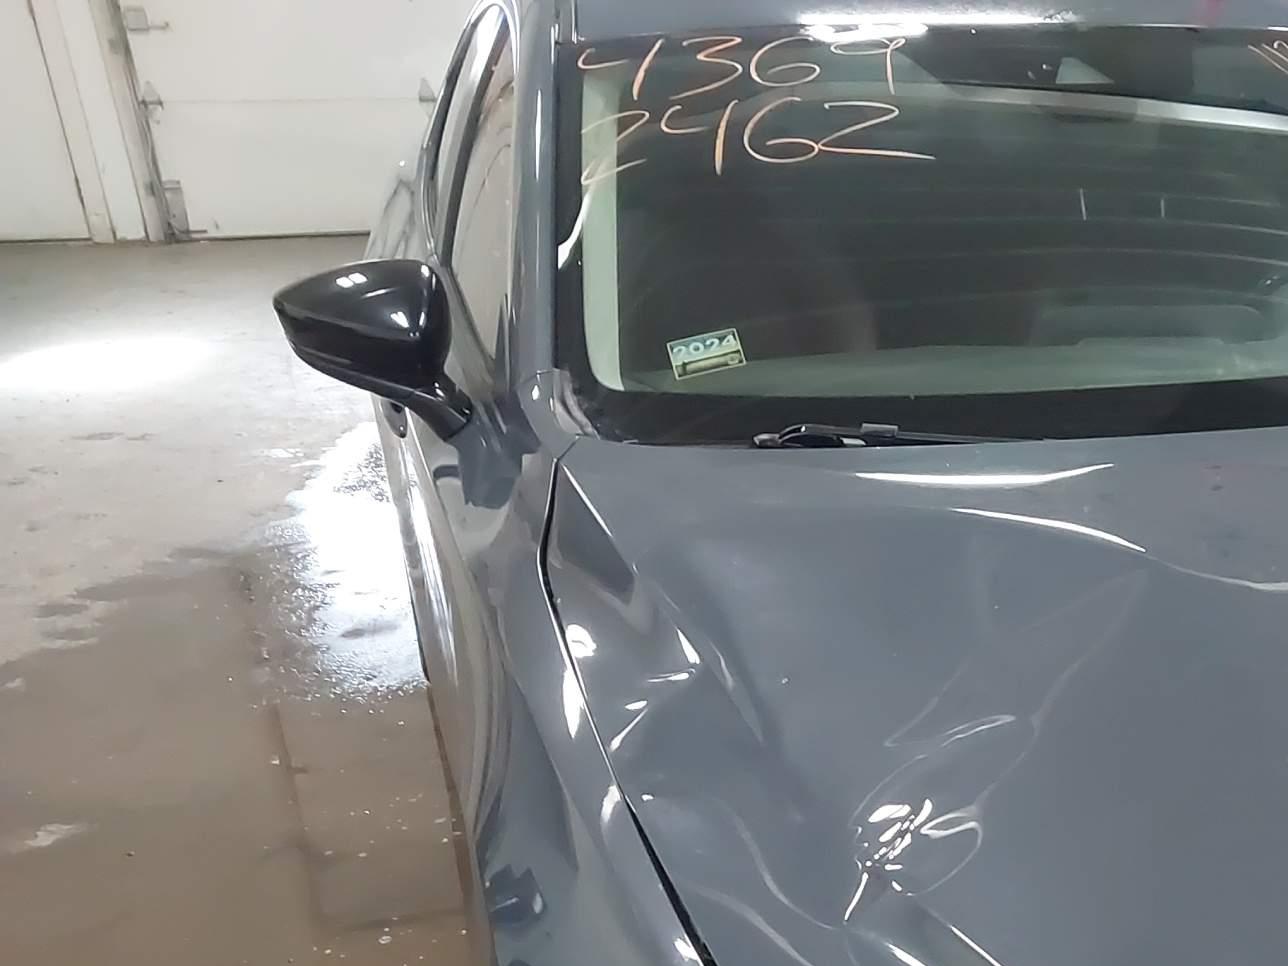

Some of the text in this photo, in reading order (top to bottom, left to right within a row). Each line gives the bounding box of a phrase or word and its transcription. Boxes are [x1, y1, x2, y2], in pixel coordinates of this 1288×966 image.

[577, 36, 906, 101] 4369
[580, 97, 936, 185] 2462
[672, 334, 737, 359] 2024
